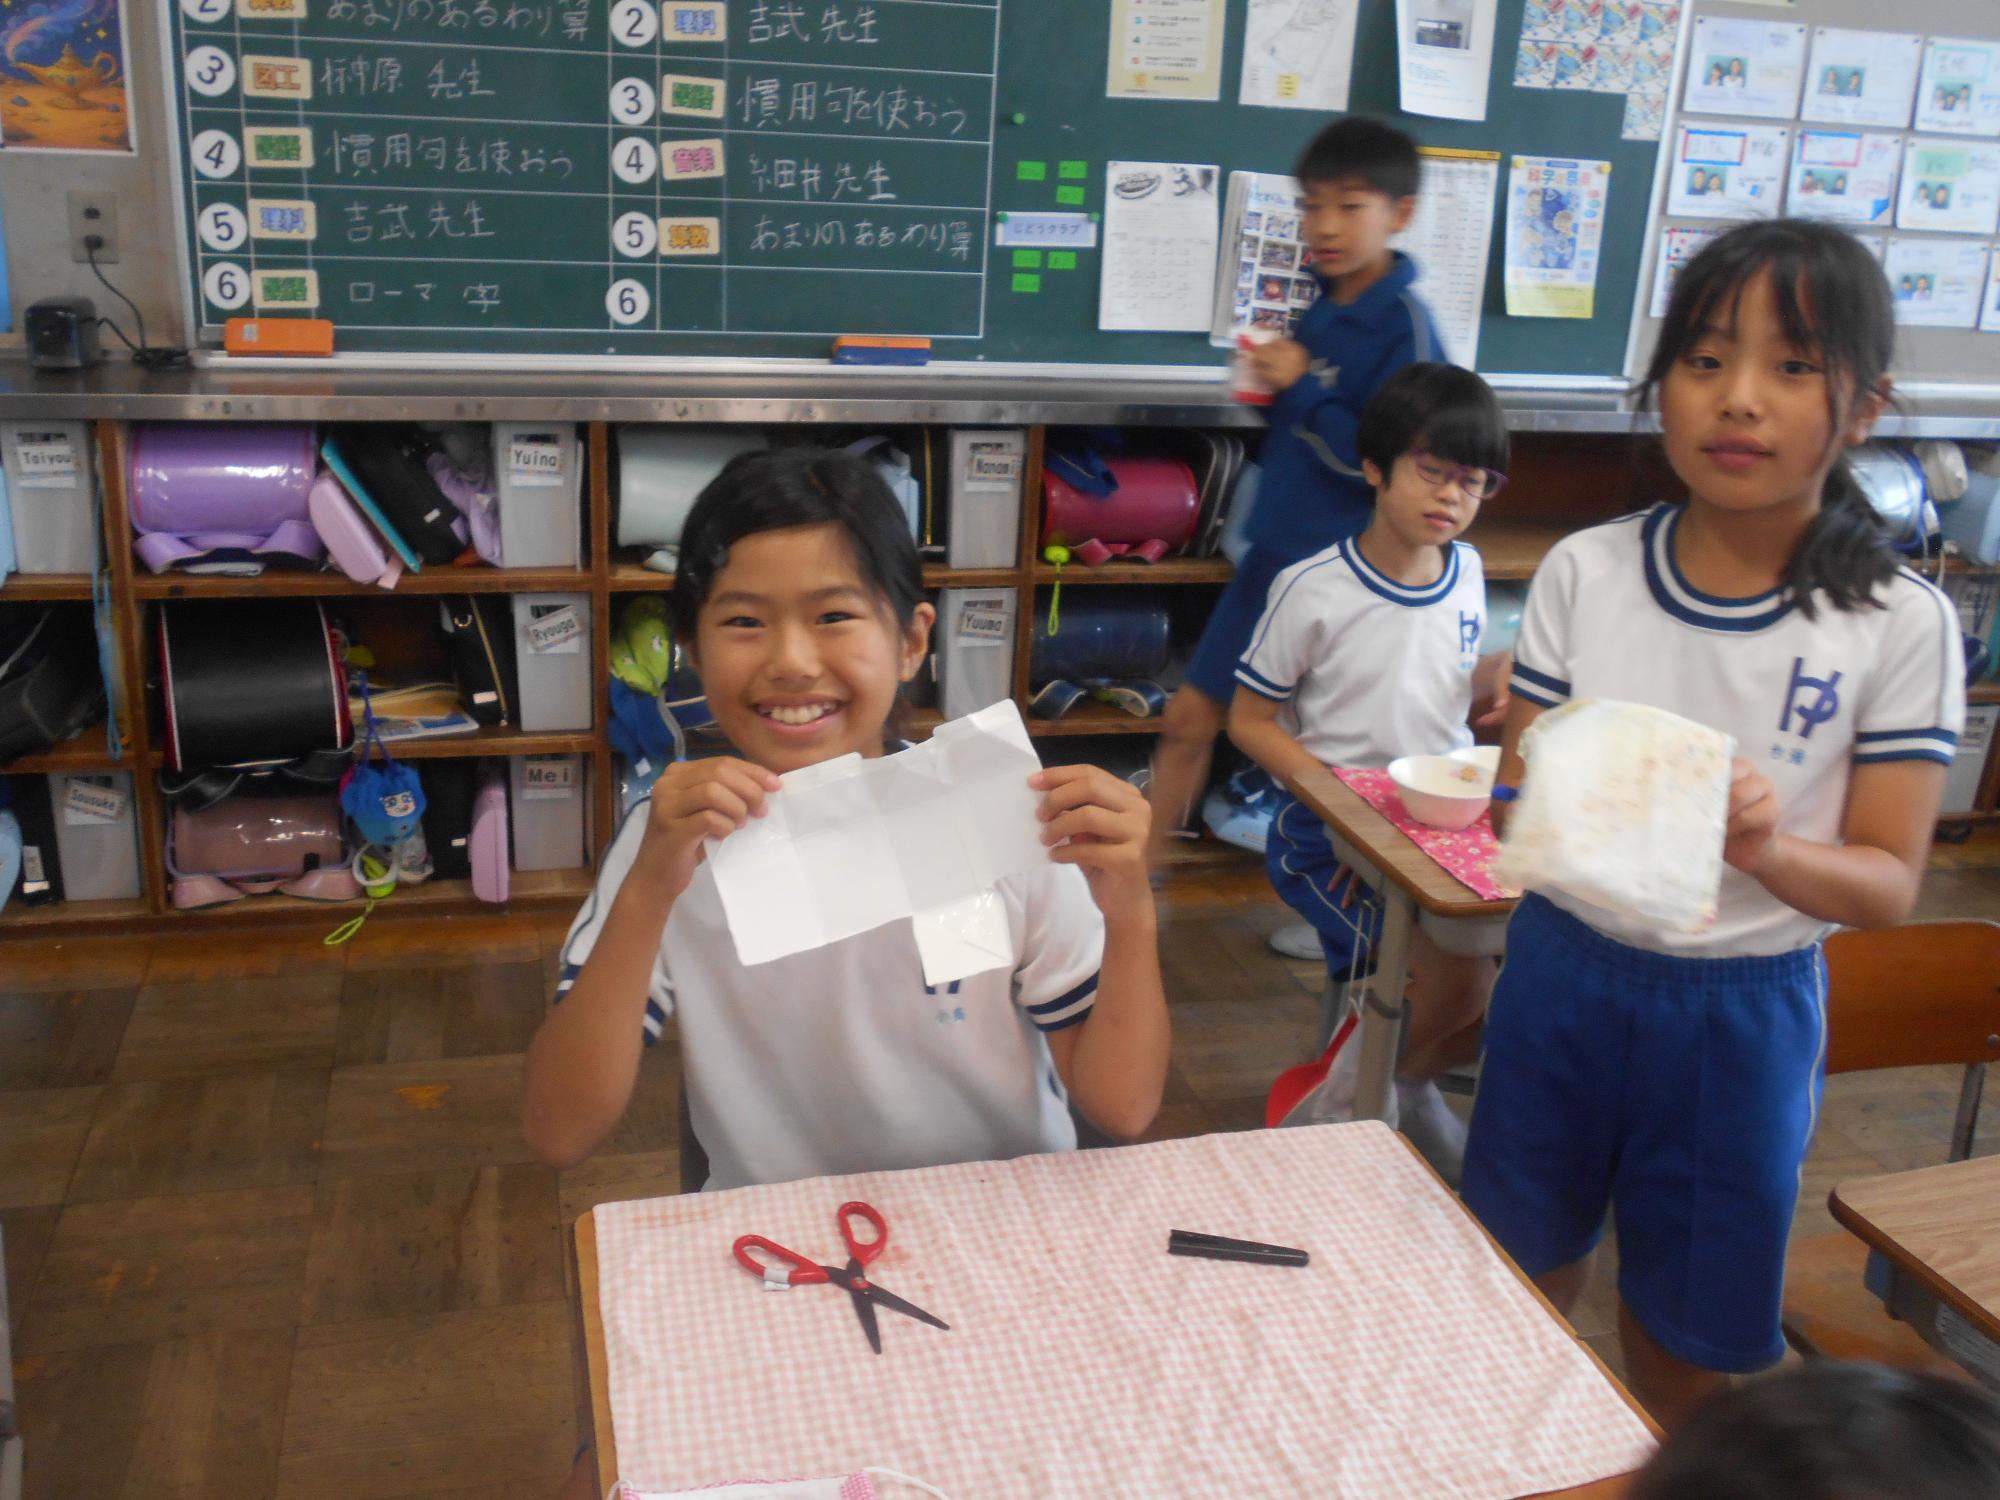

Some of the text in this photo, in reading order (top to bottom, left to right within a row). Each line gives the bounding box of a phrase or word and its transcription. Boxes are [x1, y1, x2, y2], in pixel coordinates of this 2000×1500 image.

[626, 8, 644, 37] 2
[197, 55, 224, 85] 3
[623, 85, 642, 115] 3
[204, 140, 225, 169] 4
[625, 145, 644, 174] 4
[213, 211, 234, 241] 5
[627, 220, 644, 248] 5
[218, 271, 237, 300] 6
[618, 287, 637, 315] 6
[514, 449, 557, 467] Yuina
[528, 767, 568, 782] Mei
